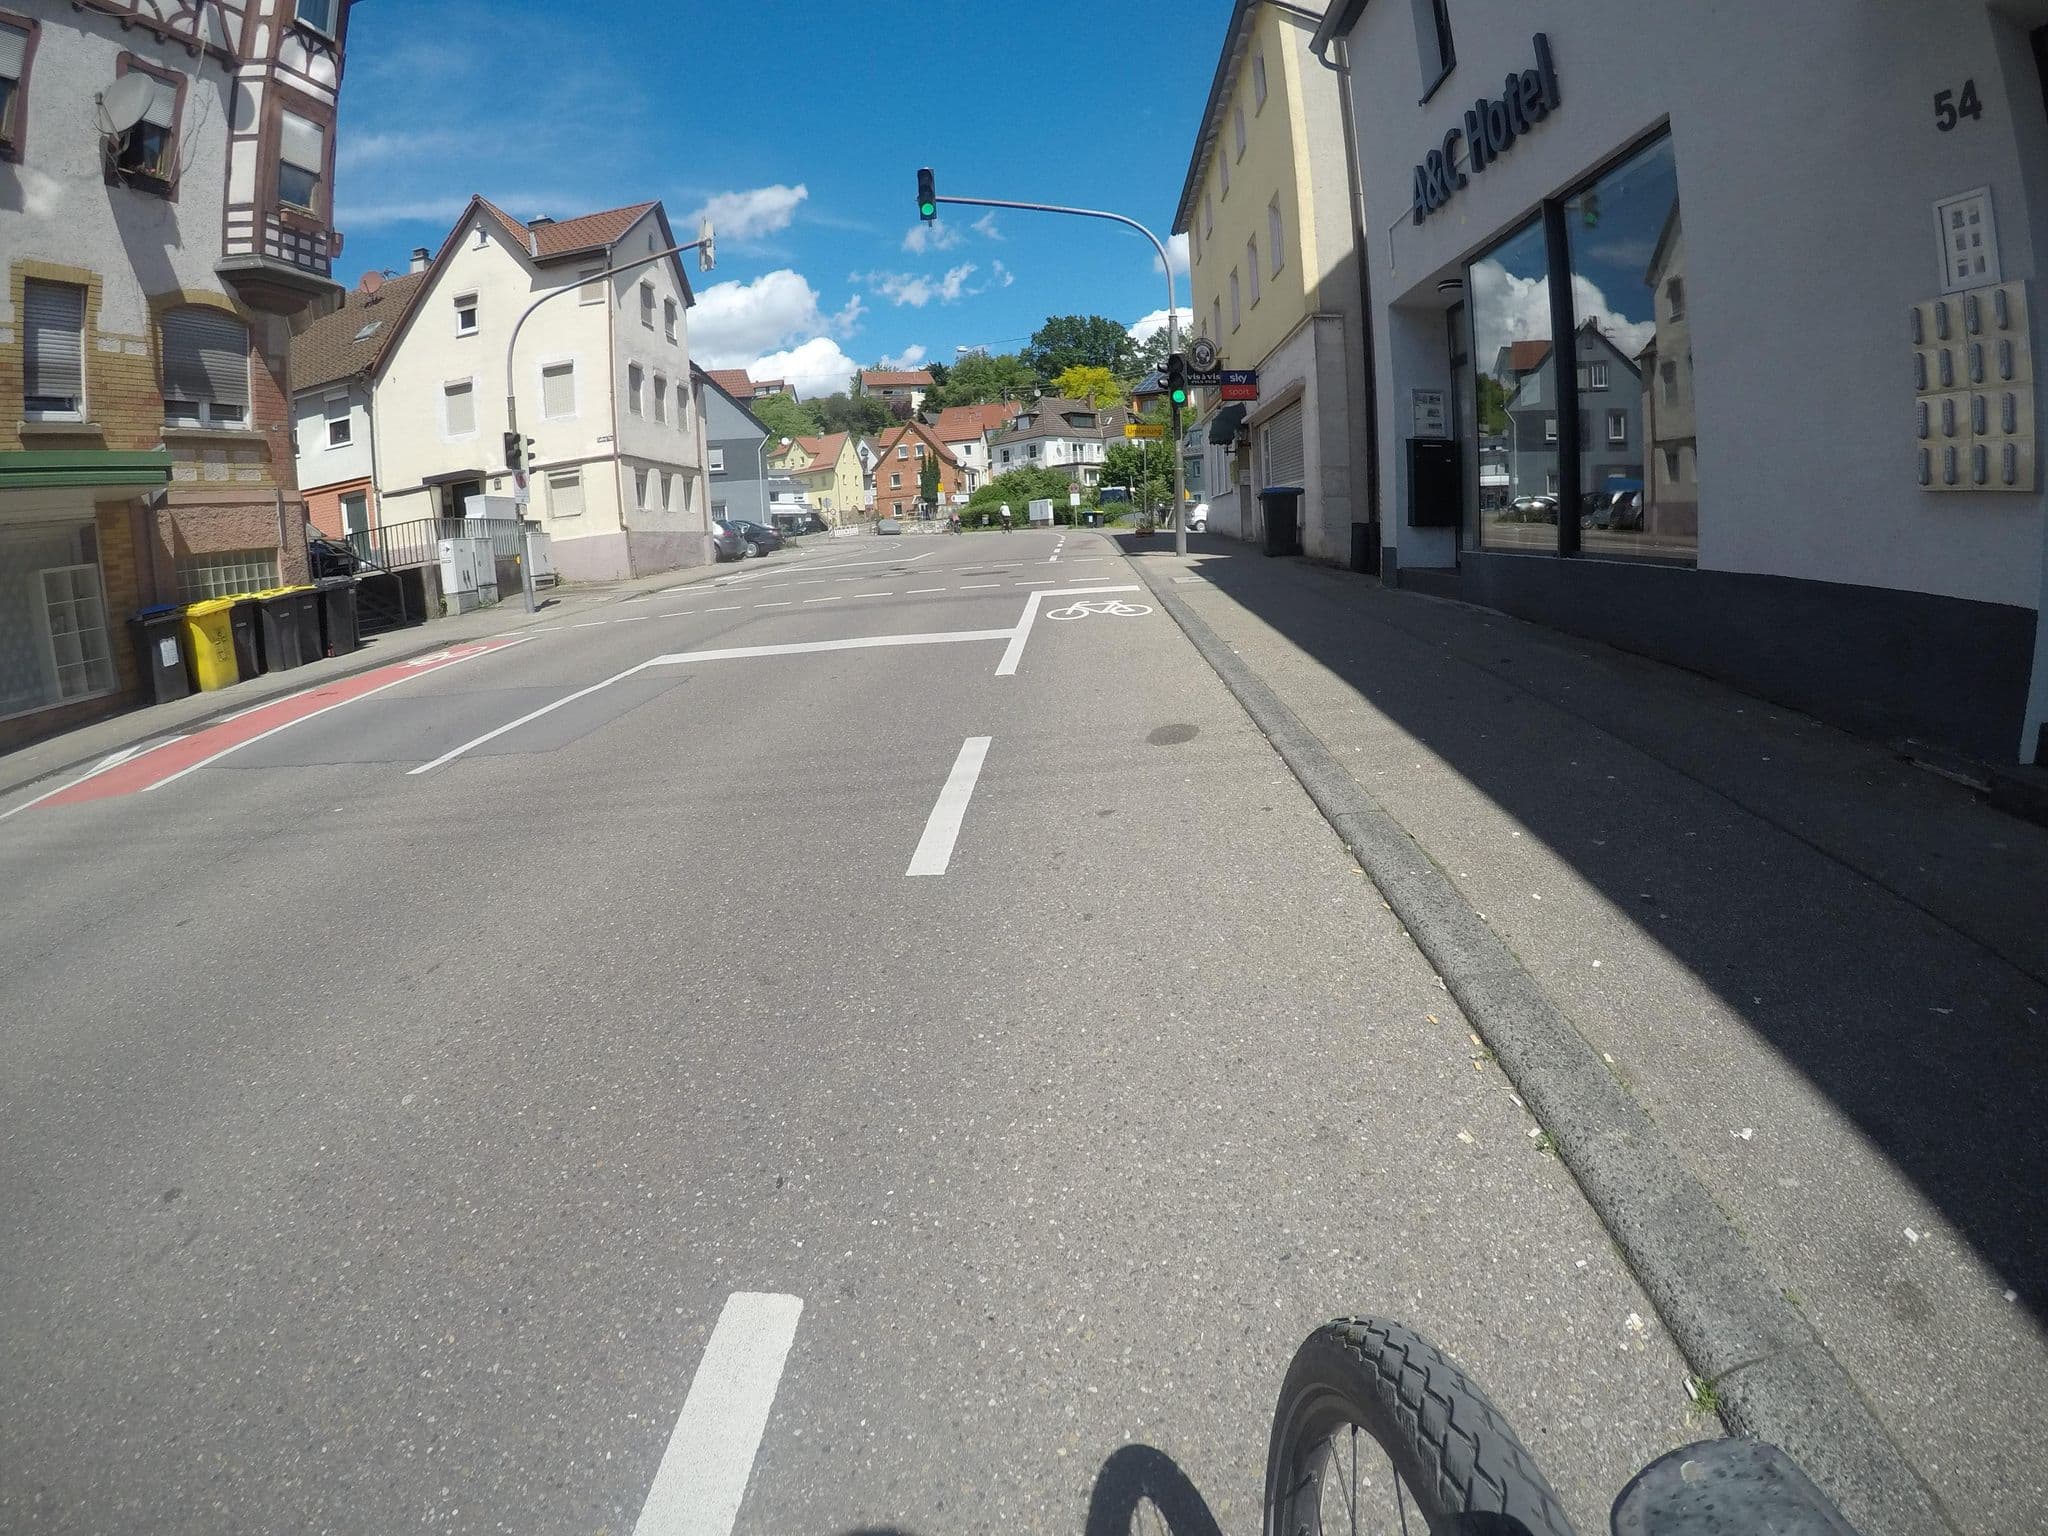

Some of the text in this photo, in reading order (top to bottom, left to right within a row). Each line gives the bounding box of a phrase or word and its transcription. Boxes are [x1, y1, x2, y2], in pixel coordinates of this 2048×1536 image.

[1934, 78, 1982, 132] 54
[1412, 32, 1561, 226] A&C Hotel
[1229, 373, 1248, 383] sky
[1228, 388, 1251, 397] sport
[1127, 427, 1162, 436] Umleitung
